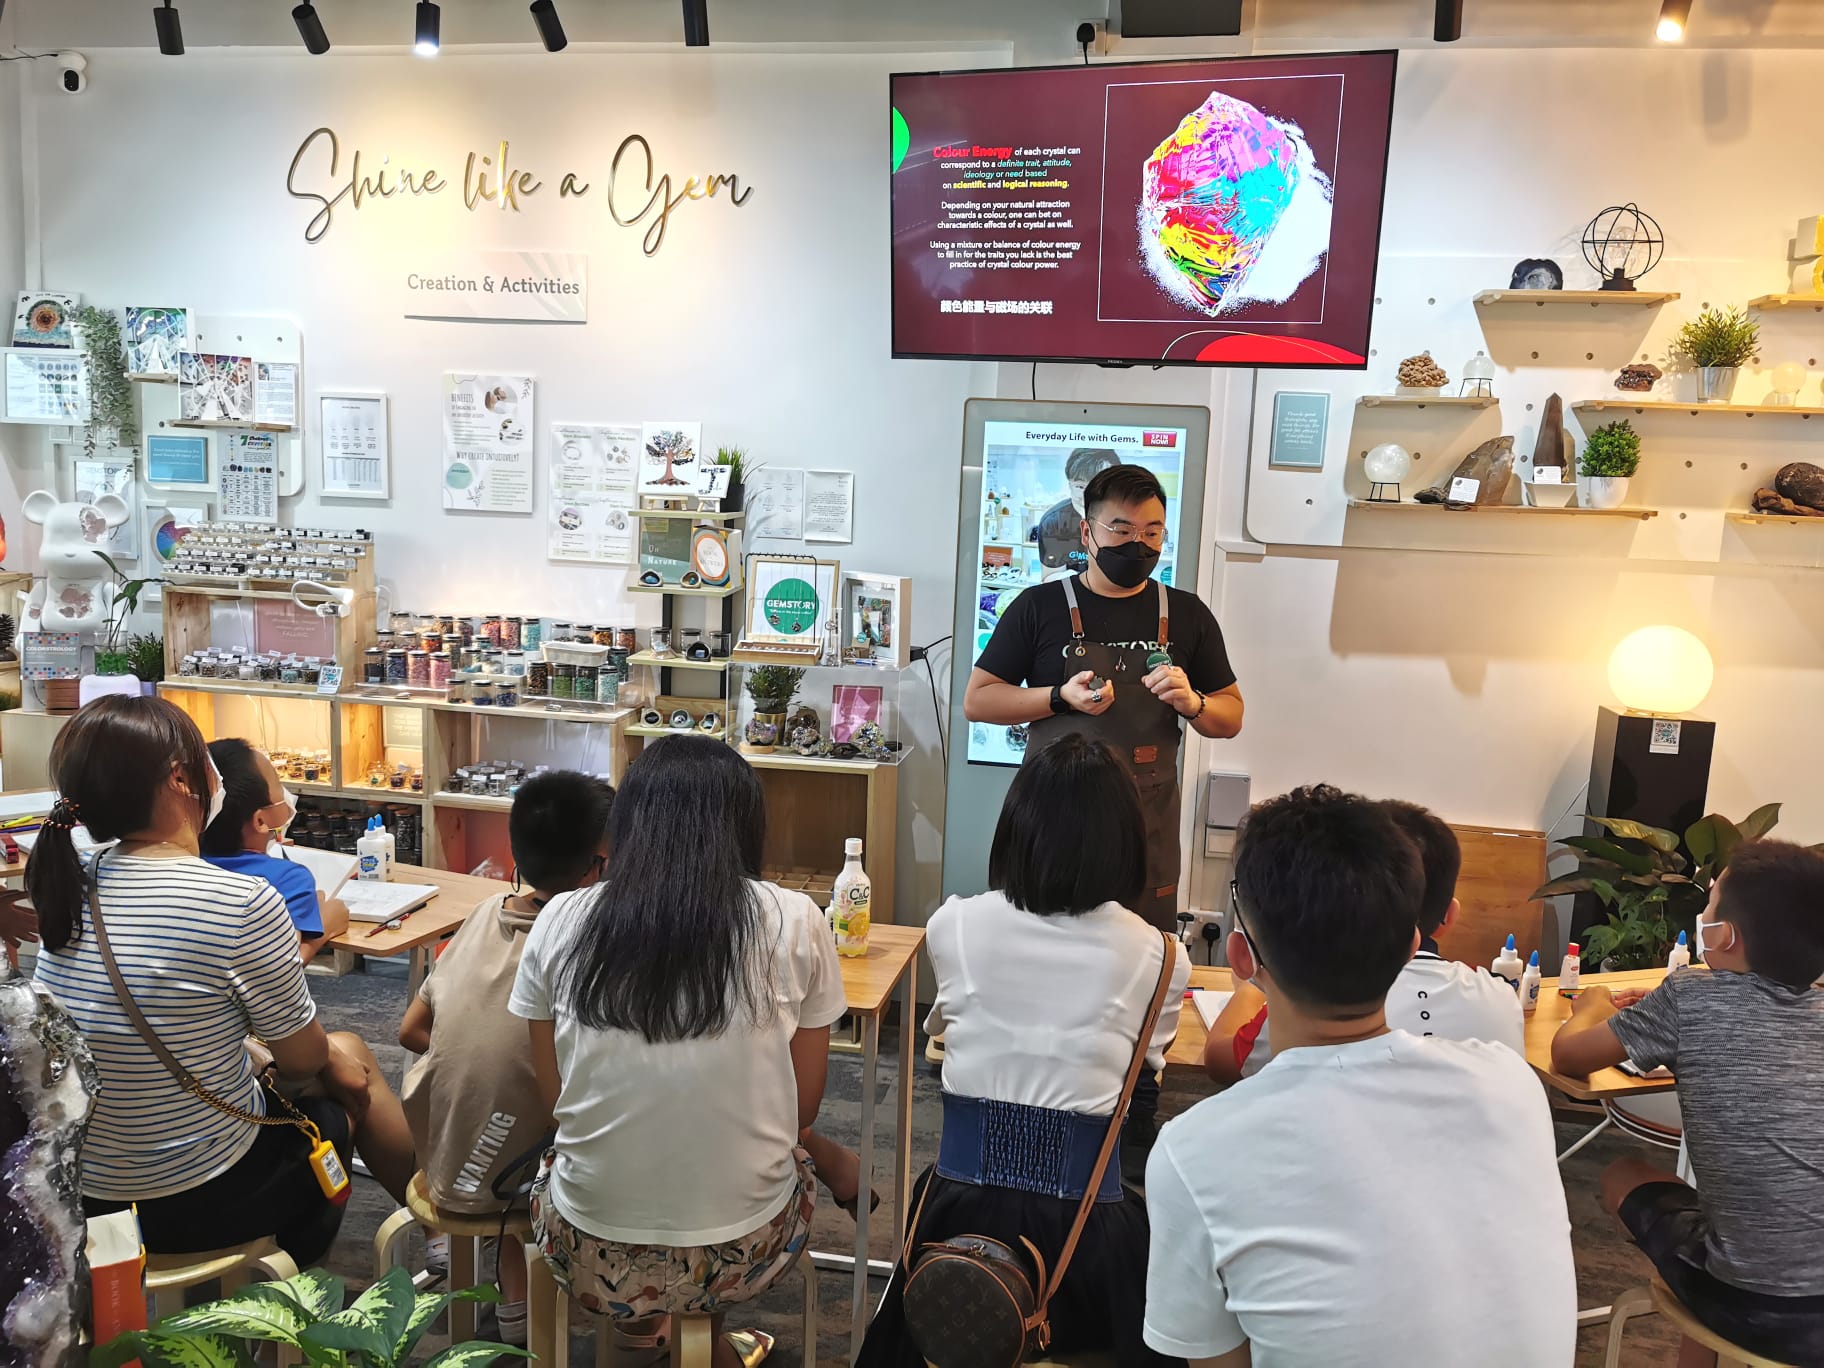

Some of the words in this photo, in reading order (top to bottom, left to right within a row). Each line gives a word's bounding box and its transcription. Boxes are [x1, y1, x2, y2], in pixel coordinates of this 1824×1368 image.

[933, 146, 970, 158] Colour
[972, 145, 1013, 159] Energy
[1015, 146, 1023, 156] of
[1023, 146, 1041, 156] each
[1042, 146, 1066, 157] crystal
[1067, 147, 1081, 155] can
[941, 159, 981, 171] correspond
[982, 160, 990, 169] to
[997, 159, 1025, 168] definite
[1025, 159, 1042, 168] trait,
[1043, 158, 1072, 168] attitude,
[963, 170, 994, 180] ideology
[1005, 170, 1024, 178] need
[1025, 170, 1048, 178] based
[942, 182, 952, 190] on
[953, 180, 987, 190] scientific
[987, 180, 1001, 189] and
[1002, 179, 1029, 190] logical
[1029, 179, 1070, 190] reasoning.
[286, 127, 447, 244] Shine
[464, 140, 543, 213] like
[560, 171, 590, 198] a
[608, 134, 755, 257] Gem
[941, 201, 981, 211] Depending
[992, 201, 1009, 211] your
[1010, 200, 1035, 209] natural
[1035, 200, 1070, 209] attraction
[948, 211, 977, 219] towards
[983, 211, 1008, 220] colour,
[1008, 211, 1022, 219] one
[1023, 211, 1038, 219] can
[1052, 211, 1062, 219] on
[937, 220, 983, 230] characteristic
[983, 220, 1007, 229] effects
[1007, 220, 1016, 229] of
[1022, 220, 1046, 230] crystal
[1056, 219, 1074, 229] well.
[929, 241, 950, 250] Using
[956, 241, 983, 249] mixture
[983, 241, 992, 249] or
[993, 240, 1021, 249] balance
[1021, 240, 1031, 249] of
[1031, 240, 1054, 249] colour
[1055, 241, 1081, 251] energy
[937, 251, 945, 259] to
[945, 250, 955, 259] fill
[955, 250, 962, 259] in
[963, 250, 973, 259] for
[974, 250, 987, 259] the
[987, 250, 1005, 259] traits
[1005, 252, 1020, 261] you
[1020, 250, 1035, 259] lack
[1035, 250, 1042, 259] is
[1042, 250, 1056, 259] the
[1056, 250, 1073, 259] best
[949, 260, 977, 270] practice
[977, 260, 986, 269] of
[987, 260, 1010, 270] crystal
[1010, 260, 1034, 269] colour
[1034, 261, 1060, 270] power.
[407, 274, 478, 293] Creation
[482, 276, 496, 294] &
[499, 277, 580, 295] Activities
[1025, 431, 1067, 442] Everyday
[1069, 432, 1086, 441] Life
[1088, 433, 1109, 443] with
[1110, 434, 1139, 443] Gems.
[766, 599, 815, 610] GEMSTORY
[453, 1112, 517, 1192] WANTING
